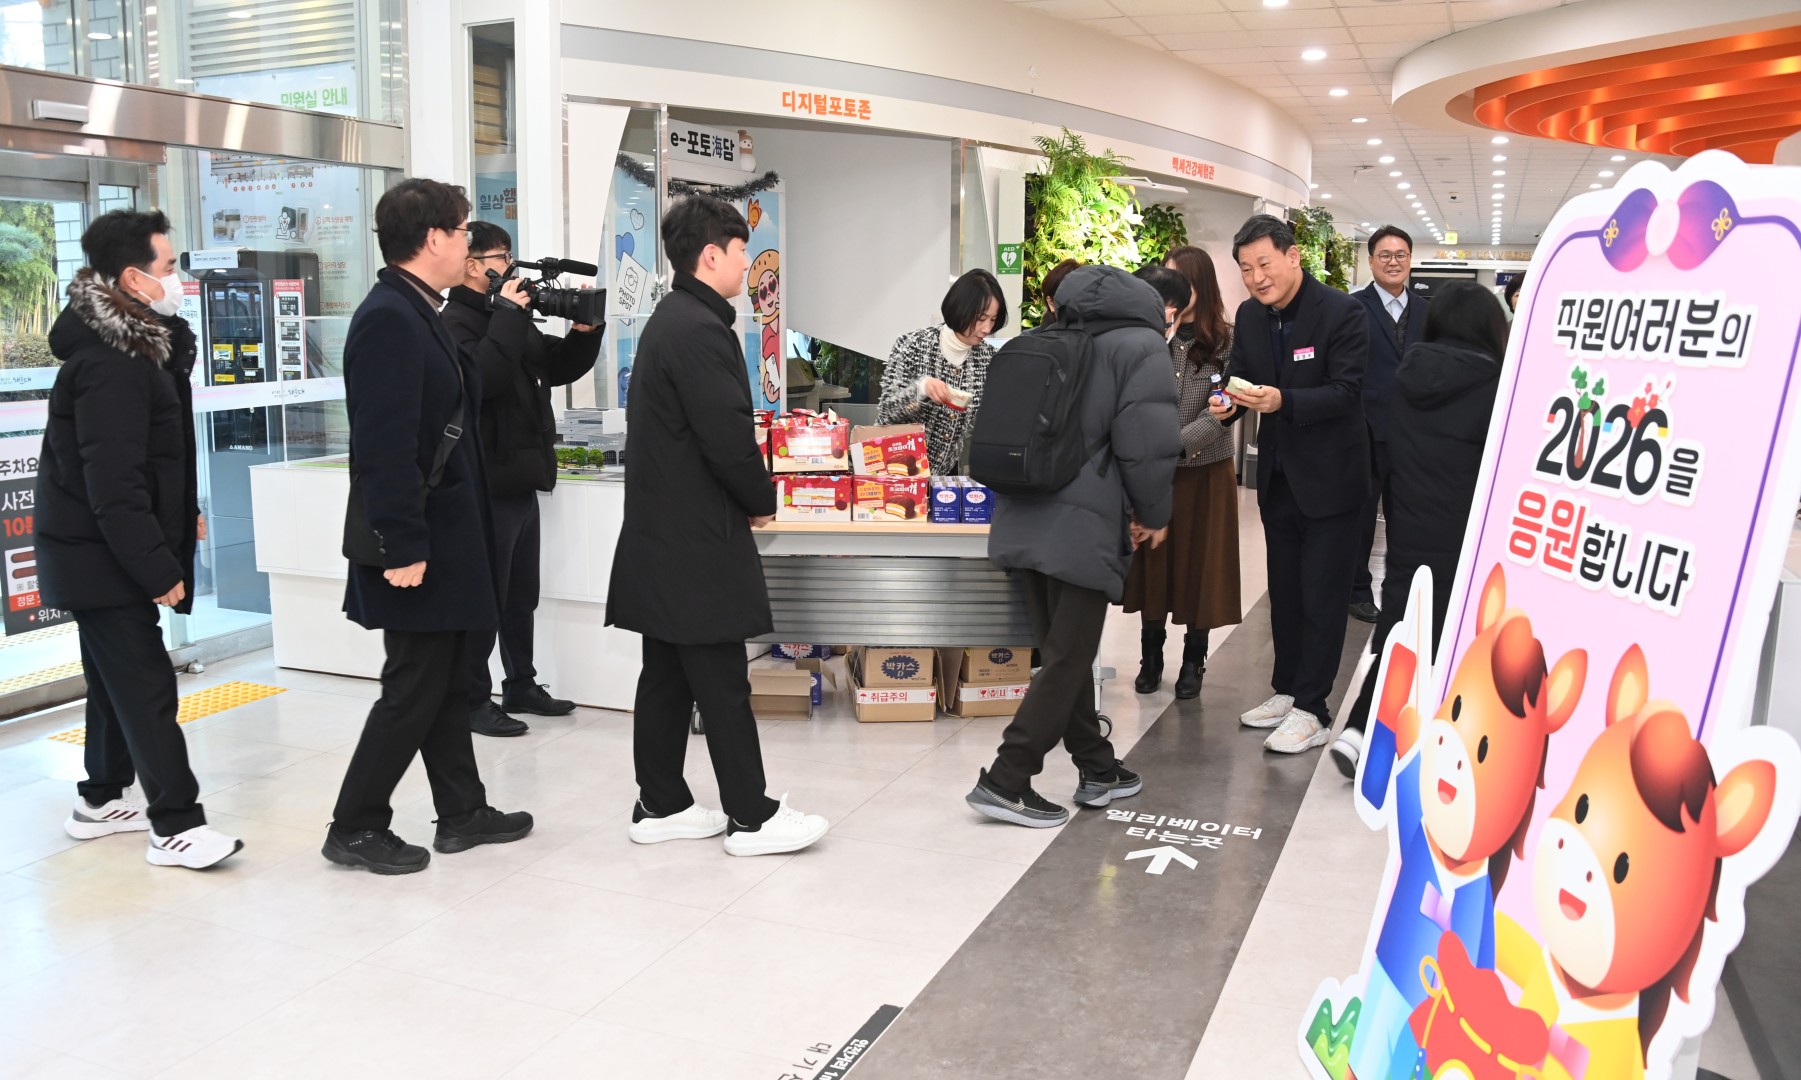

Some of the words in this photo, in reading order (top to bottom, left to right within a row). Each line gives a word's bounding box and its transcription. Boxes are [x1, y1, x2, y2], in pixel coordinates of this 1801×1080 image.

[322, 87, 348, 106] 안내
[782, 91, 871, 120] 디지털포토존
[671, 130, 735, 161] e-포토海담
[1172, 157, 1215, 180] 백세건강체험관
[619, 287, 635, 305] PHOTO
[619, 297, 632, 311] SPOT
[1556, 298, 1751, 358] 직원여러분의
[2, 489, 35, 511] 사전
[1508, 490, 1689, 606] 응원합니다
[886, 662, 915, 671] 박카스
[870, 691, 908, 702] 취급주의
[1106, 809, 1263, 840] 엘리베이터
[830, 1038, 869, 1070] 안전거리
